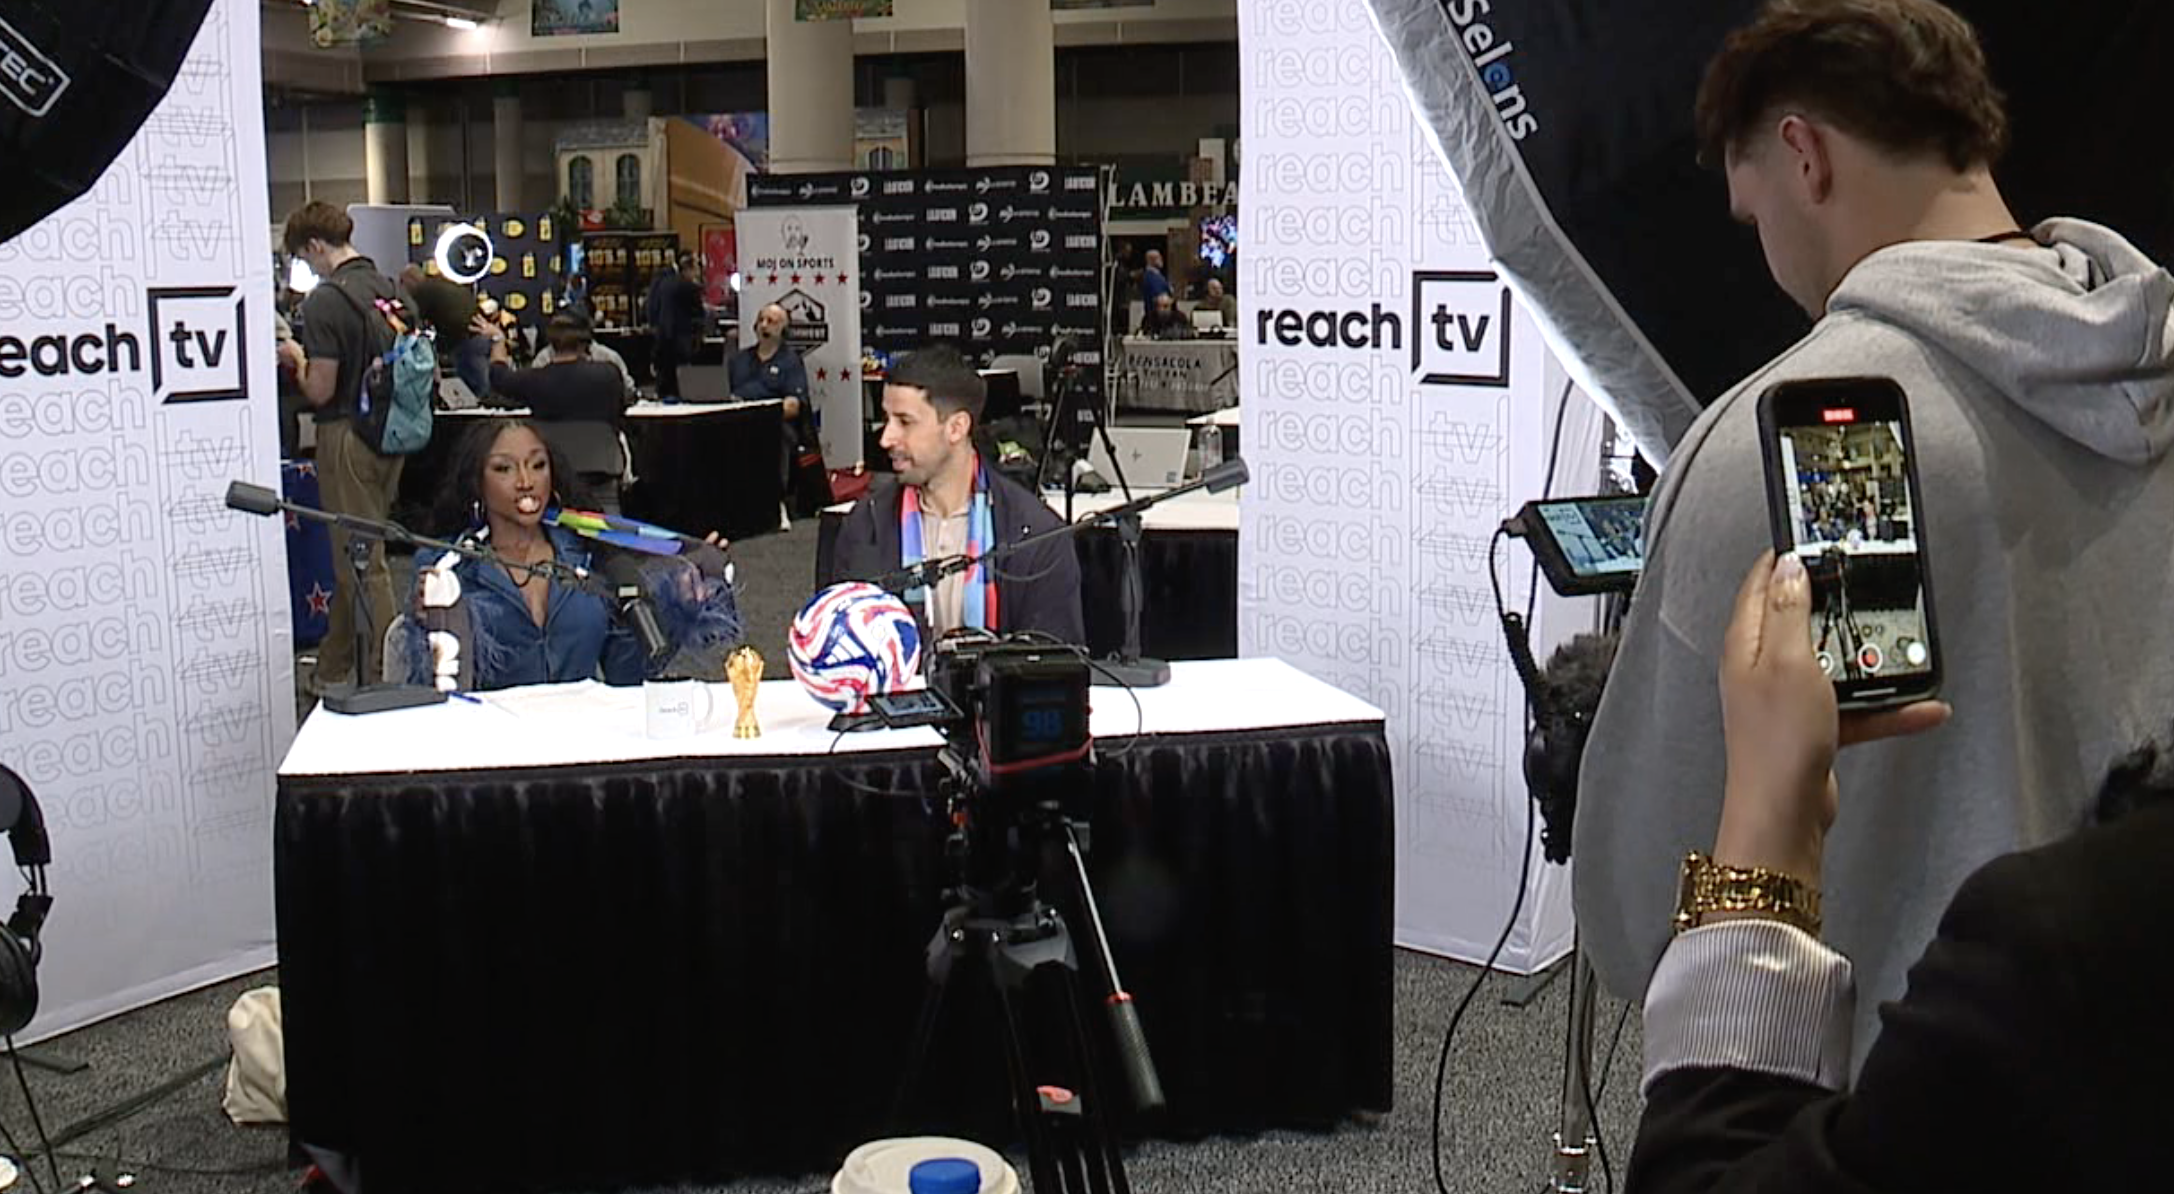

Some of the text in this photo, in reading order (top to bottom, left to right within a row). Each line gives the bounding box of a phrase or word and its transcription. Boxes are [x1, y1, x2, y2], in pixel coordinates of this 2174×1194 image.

[1254, 0, 1380, 34] reac
[0, 41, 47, 96] EC
[1255, 89, 1402, 138] reach
[1255, 143, 1402, 193] reach
[1255, 196, 1402, 246] reach
[797, 258, 834, 268] SPORTS
[1255, 249, 1402, 298] reach
[169, 321, 227, 368] tv
[1257, 303, 1490, 352] reach tv
[1257, 354, 1401, 405] reach
[177, 431, 234, 479] tv
[1257, 407, 1490, 463] reach tv
[1257, 460, 1401, 512] reach
[0, 492, 154, 556] each
[1256, 514, 1401, 565] reach
[0, 550, 158, 616] each
[1256, 566, 1401, 618] reach
[1256, 613, 1401, 668] reach
